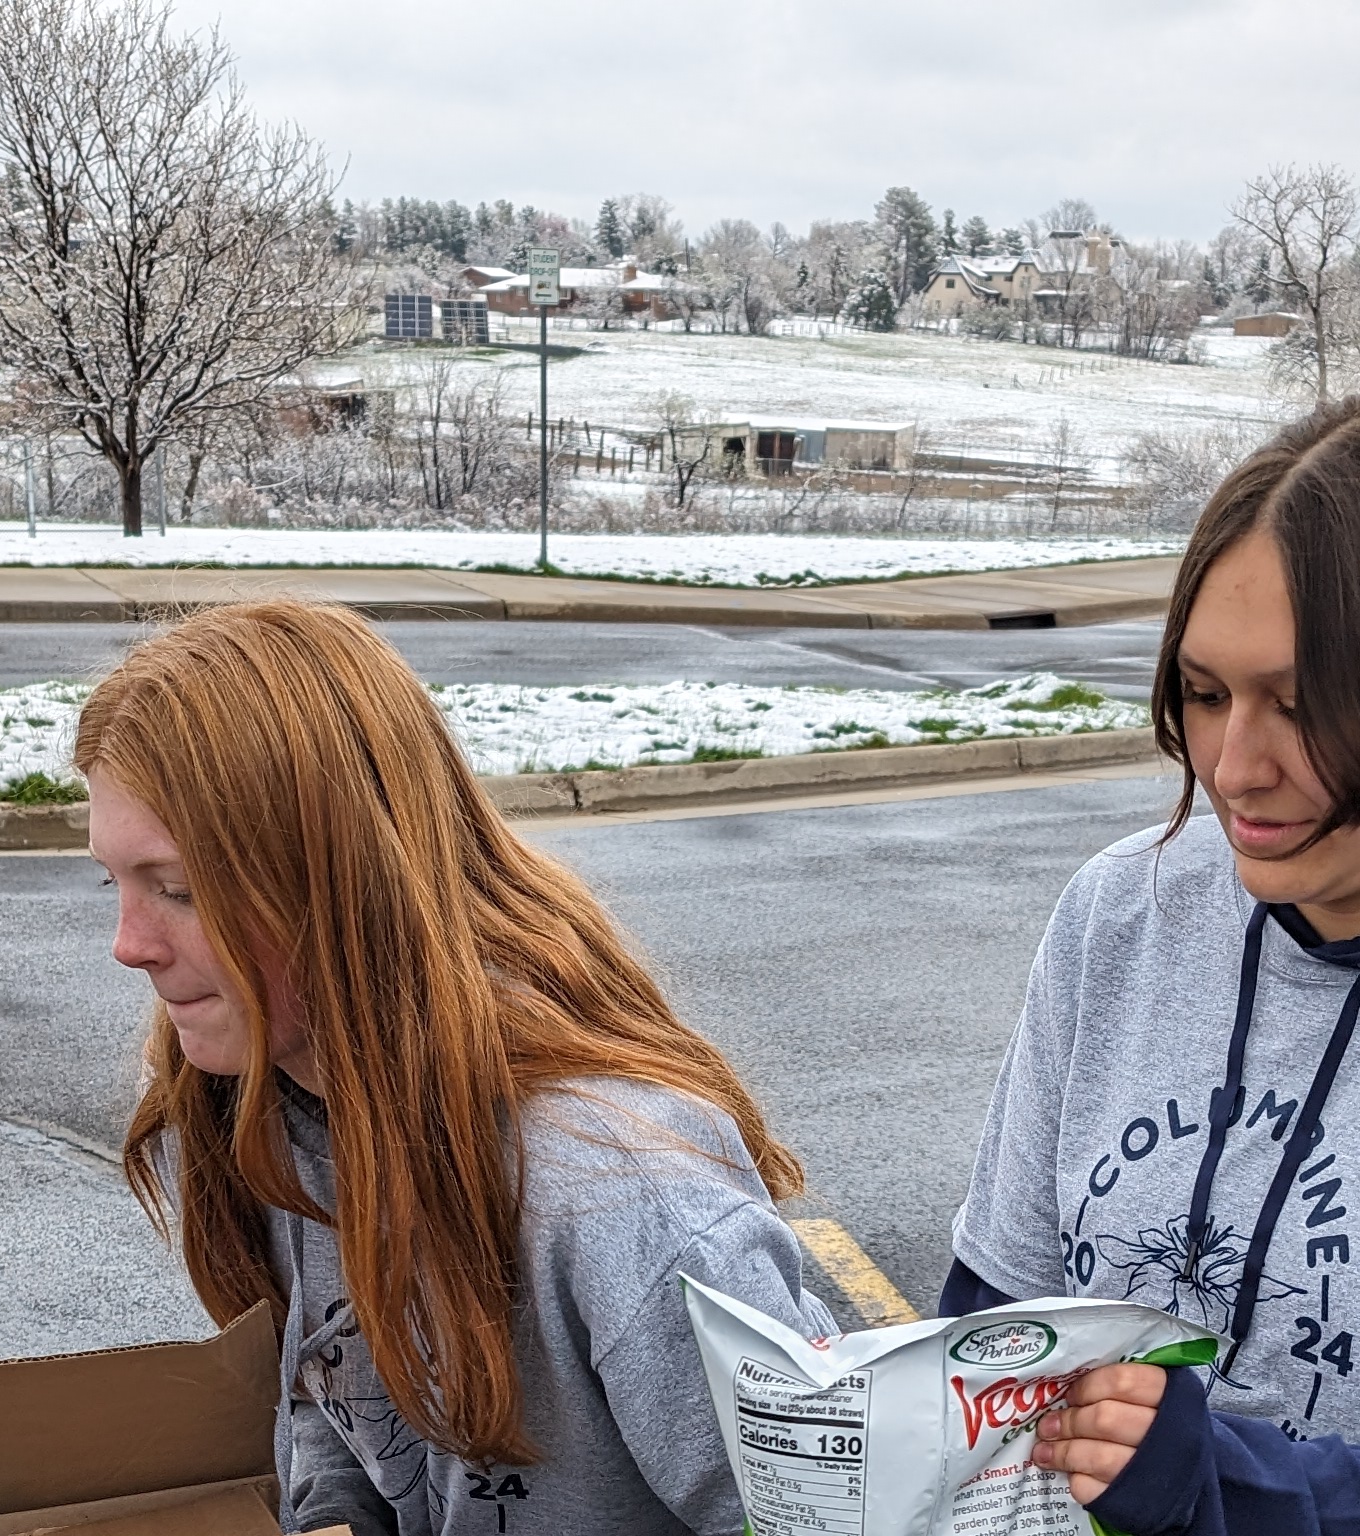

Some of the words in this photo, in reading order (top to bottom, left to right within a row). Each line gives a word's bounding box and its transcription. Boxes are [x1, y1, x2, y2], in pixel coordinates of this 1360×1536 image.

[1060, 1231, 1096, 1287] 20
[966, 1323, 1031, 1352] Sensible
[1290, 1316, 1354, 1377] 24
[978, 1340, 1042, 1362] Portions
[740, 1424, 798, 1451] Calories
[817, 1434, 863, 1456] 130
[984, 1463, 1022, 1480] Smart.
[465, 1472, 530, 1501] 24
[847, 1488, 860, 1497] 3%
[976, 1483, 1007, 1497] makes
[952, 1496, 1003, 1517] irresistible?
[953, 1516, 989, 1534] garden
[1020, 1516, 1042, 1529] 30%
[1055, 1513, 1070, 1524] fat
